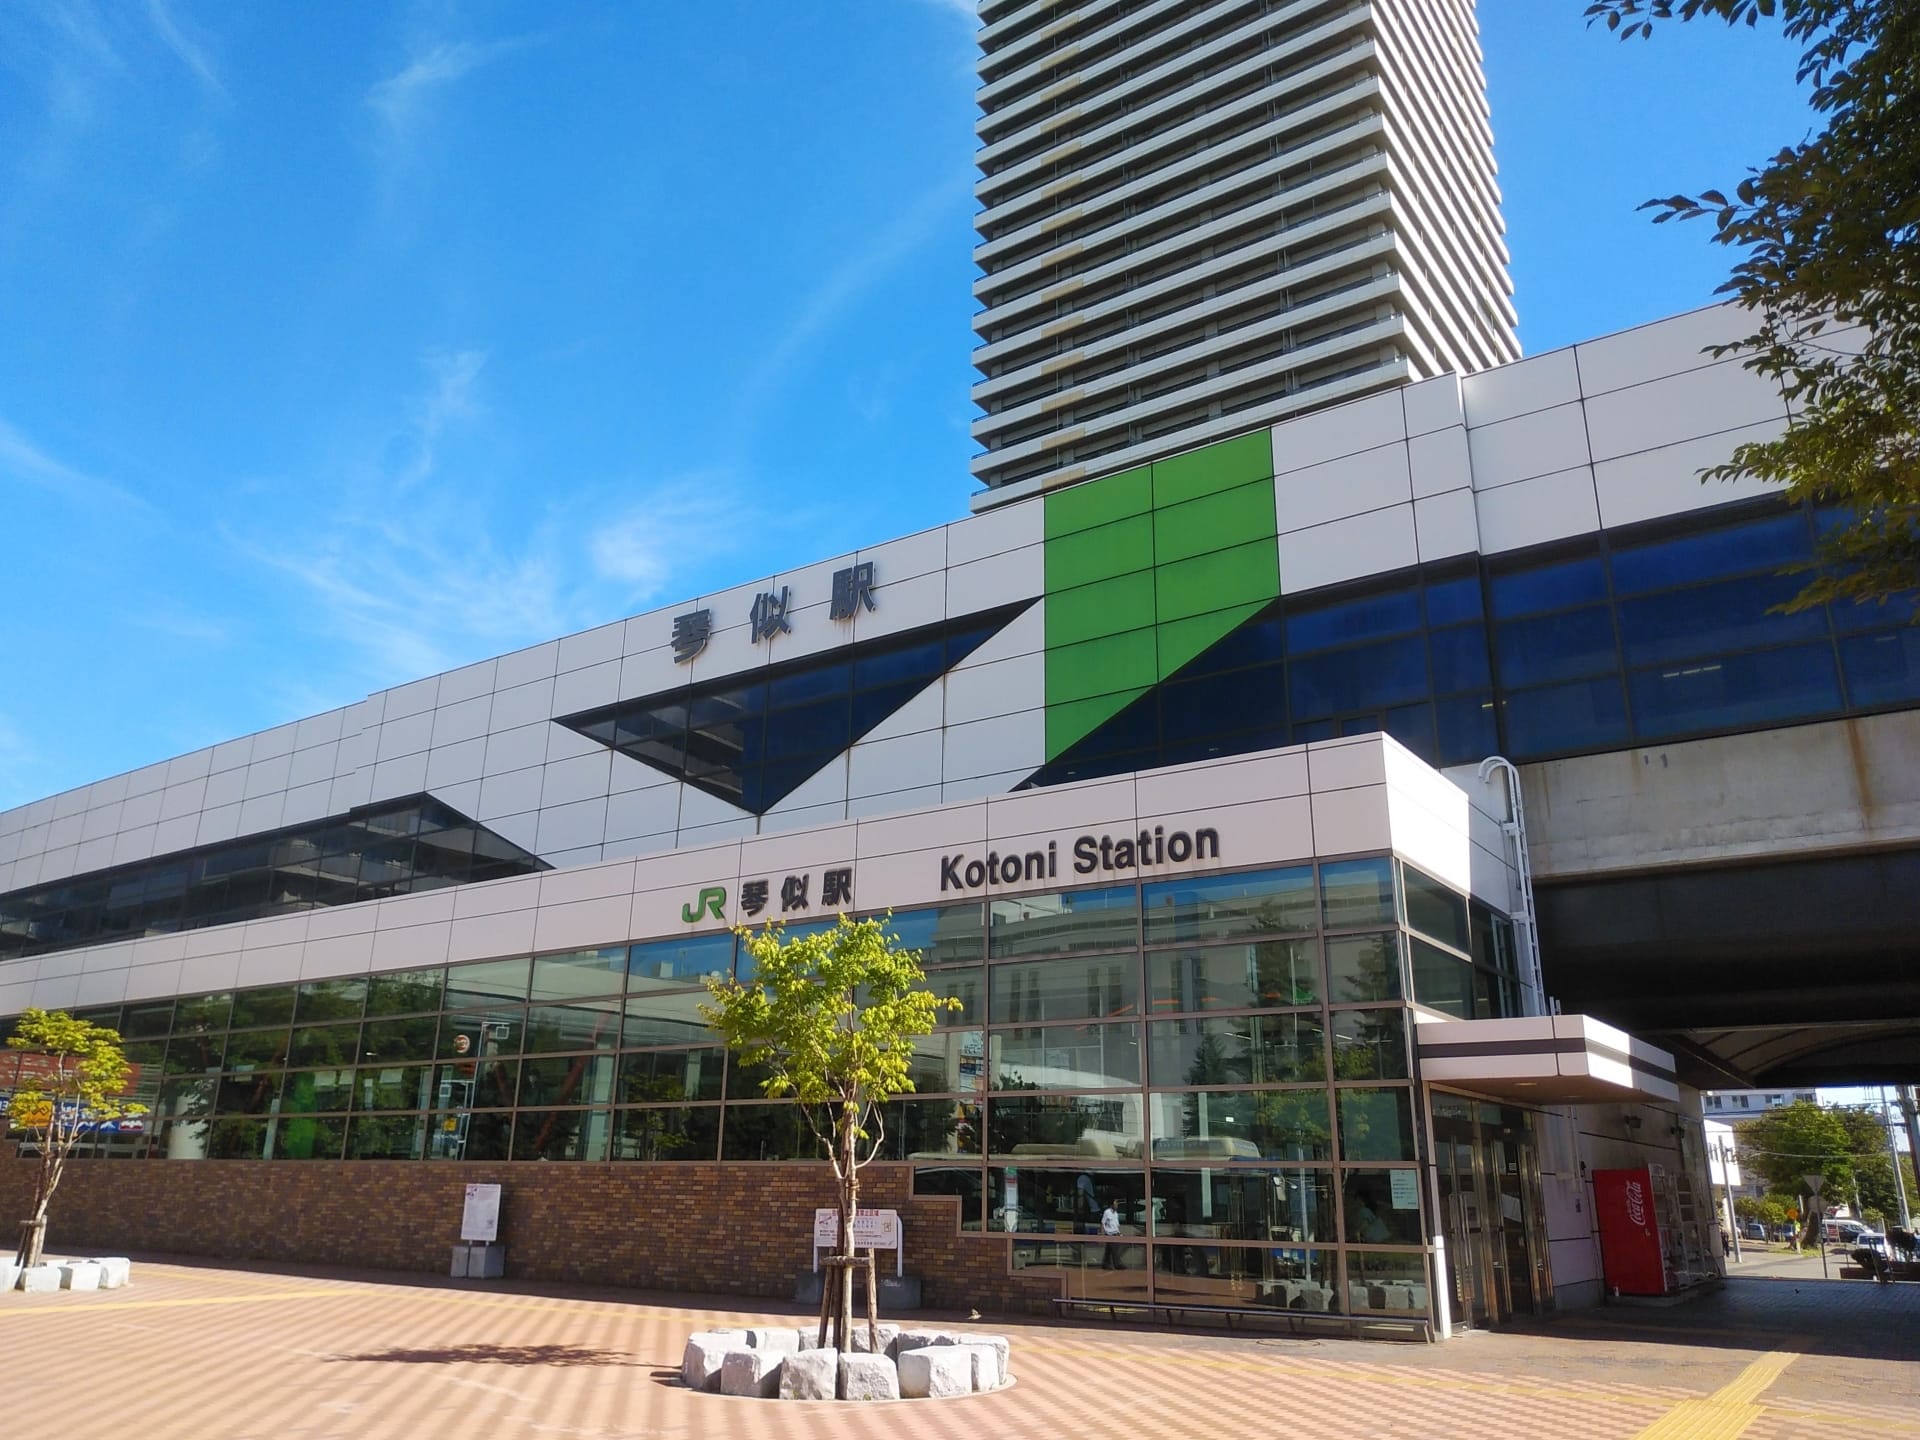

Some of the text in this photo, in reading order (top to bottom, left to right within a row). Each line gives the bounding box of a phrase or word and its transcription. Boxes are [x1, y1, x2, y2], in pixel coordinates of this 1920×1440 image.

[671, 561, 877, 664] 琴似駅
[940, 825, 1219, 891] Kotoni Station
[682, 868, 852, 923] JR 琴似駅
